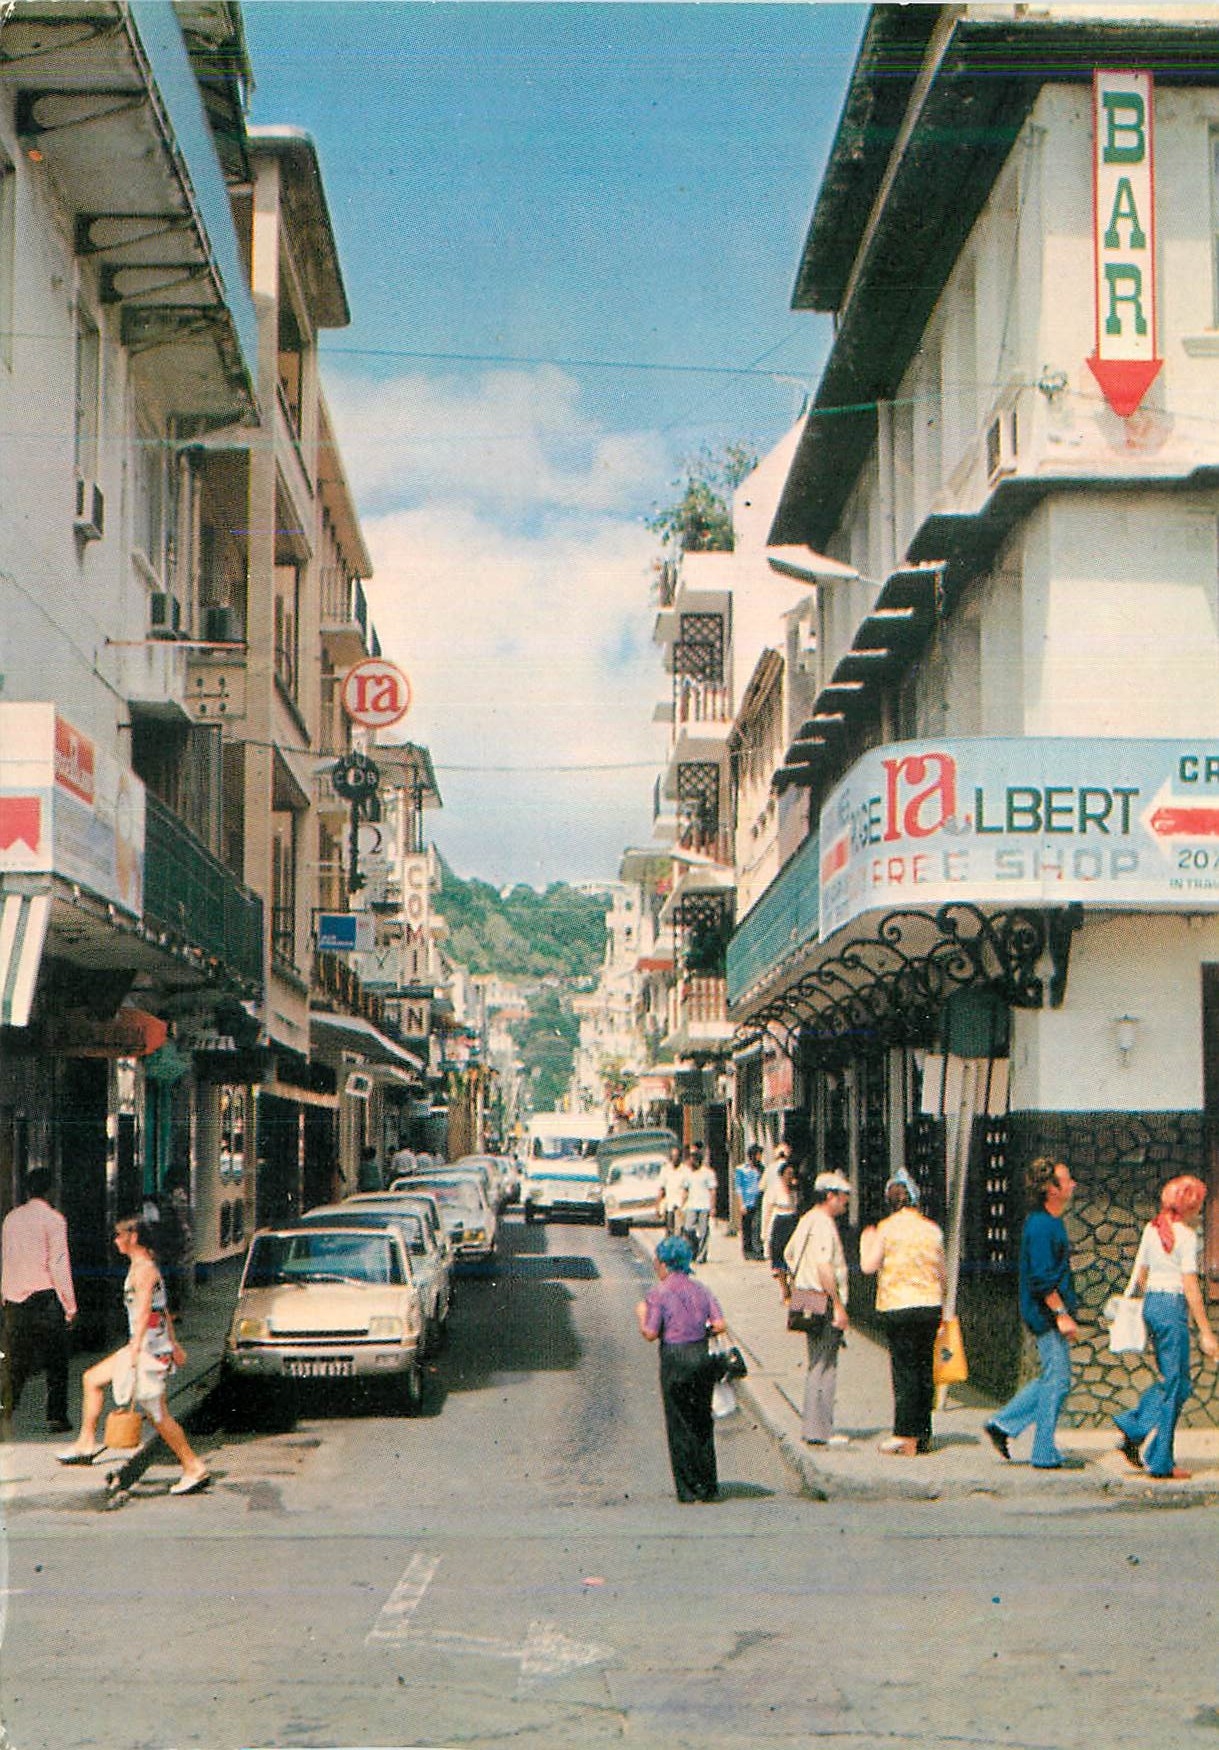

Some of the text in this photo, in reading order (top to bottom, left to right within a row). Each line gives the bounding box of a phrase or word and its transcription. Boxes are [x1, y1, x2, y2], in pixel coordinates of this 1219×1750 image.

[1102, 91, 1147, 336] BAR
[354, 673, 401, 713] ra
[872, 848, 1140, 885] FREE SHOP
